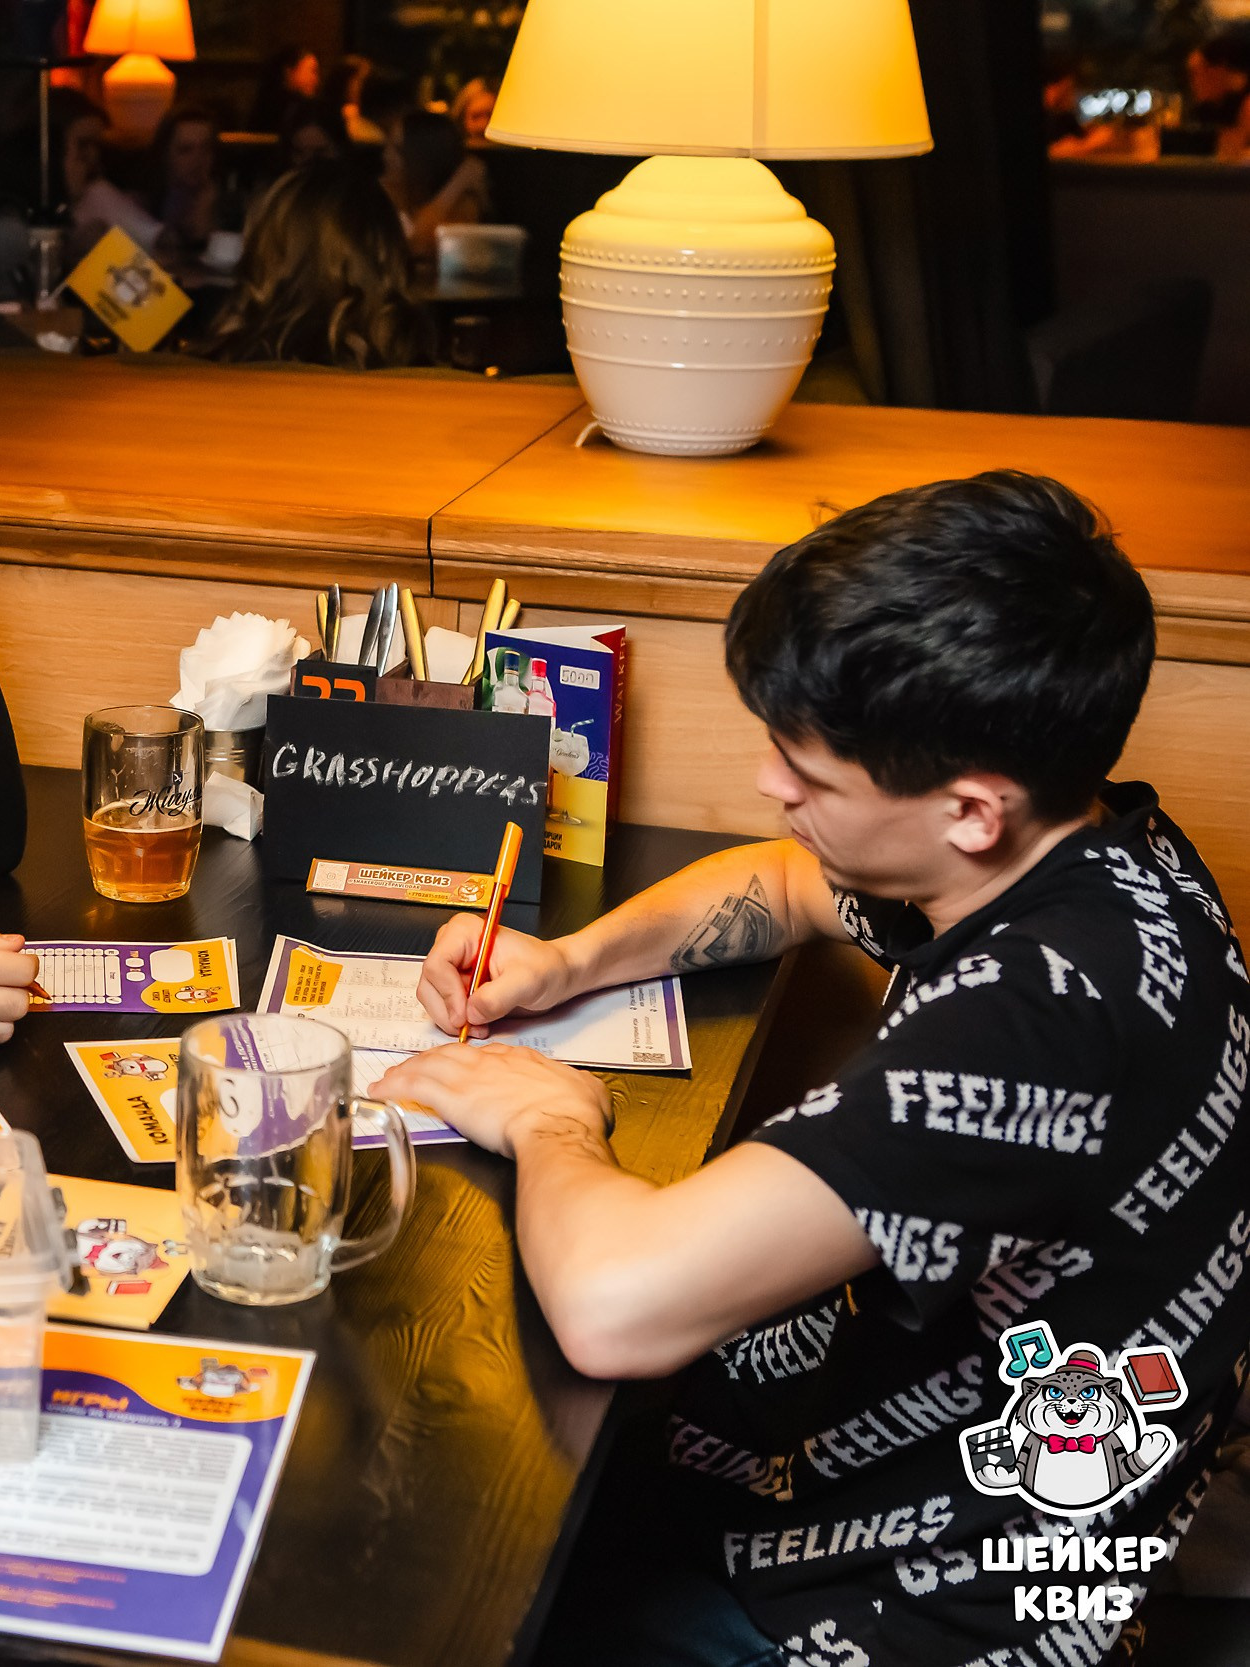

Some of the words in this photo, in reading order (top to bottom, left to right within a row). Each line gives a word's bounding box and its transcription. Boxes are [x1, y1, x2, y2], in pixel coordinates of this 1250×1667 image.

[273, 742, 548, 806] GRASSHOPPERS
[359, 868, 412, 882] ШЕЙКЕР
[415, 873, 451, 886] КВИЗ
[127, 1095, 172, 1146] КОМАНДА
[1109, 1004, 1250, 1236] FEELINGS
[724, 1494, 956, 1579] FEELINGS
